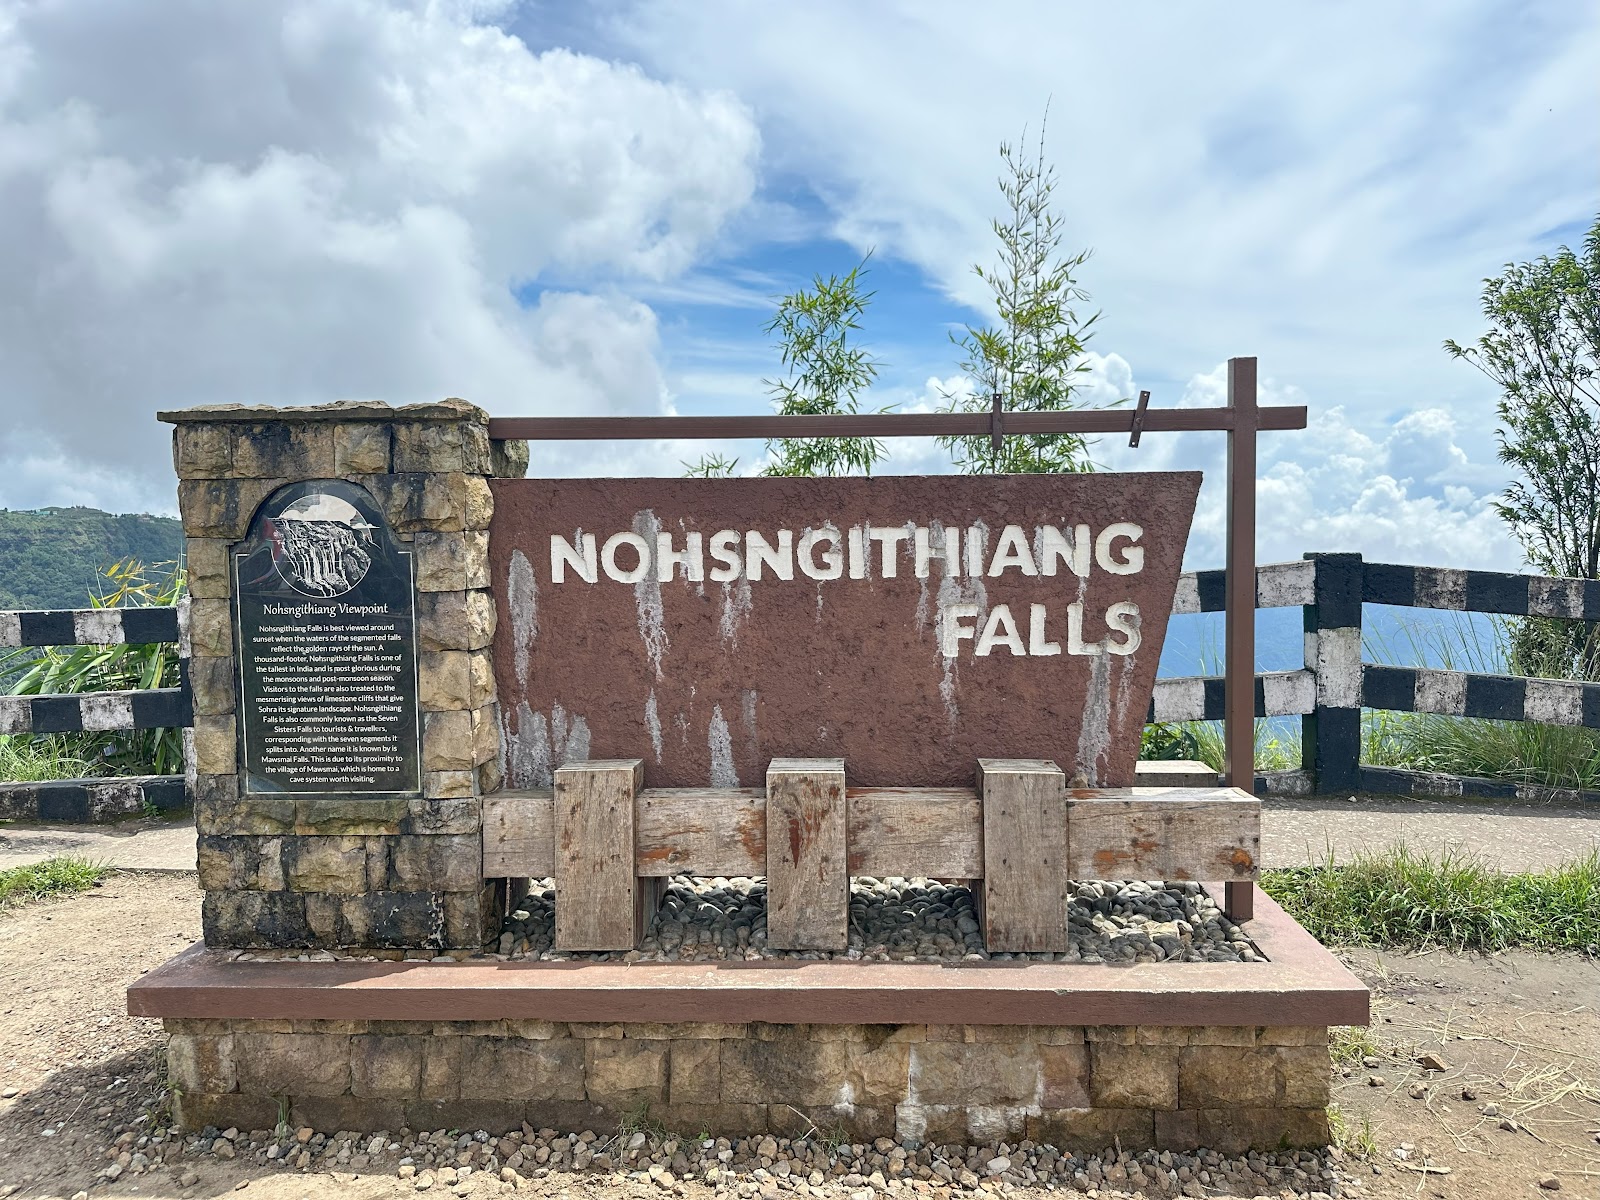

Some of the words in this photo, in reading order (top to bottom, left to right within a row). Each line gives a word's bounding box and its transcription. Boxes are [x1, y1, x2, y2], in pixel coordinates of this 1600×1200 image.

[550, 522, 1145, 584] NOHSNGITHIANG
[263, 602, 337, 618] Nohsngithiang
[337, 603, 388, 617] Viewpoint
[259, 625, 306, 633] Nohsngithiang
[943, 602, 1141, 658] FALLS
[350, 634, 386, 642] segmented
[305, 645, 328, 653] golden
[254, 654, 308, 662] thousand-footer,
[309, 655, 357, 663] Nohsngithiang
[351, 665, 378, 673] glorious
[379, 664, 401, 672] during
[256, 696, 296, 704] mesmerising
[287, 706, 318, 714] signature
[354, 705, 402, 713] Nohsngithiang
[265, 736, 312, 744] corresponding
[363, 755, 394, 763] proximity
[277, 766, 298, 774] village
